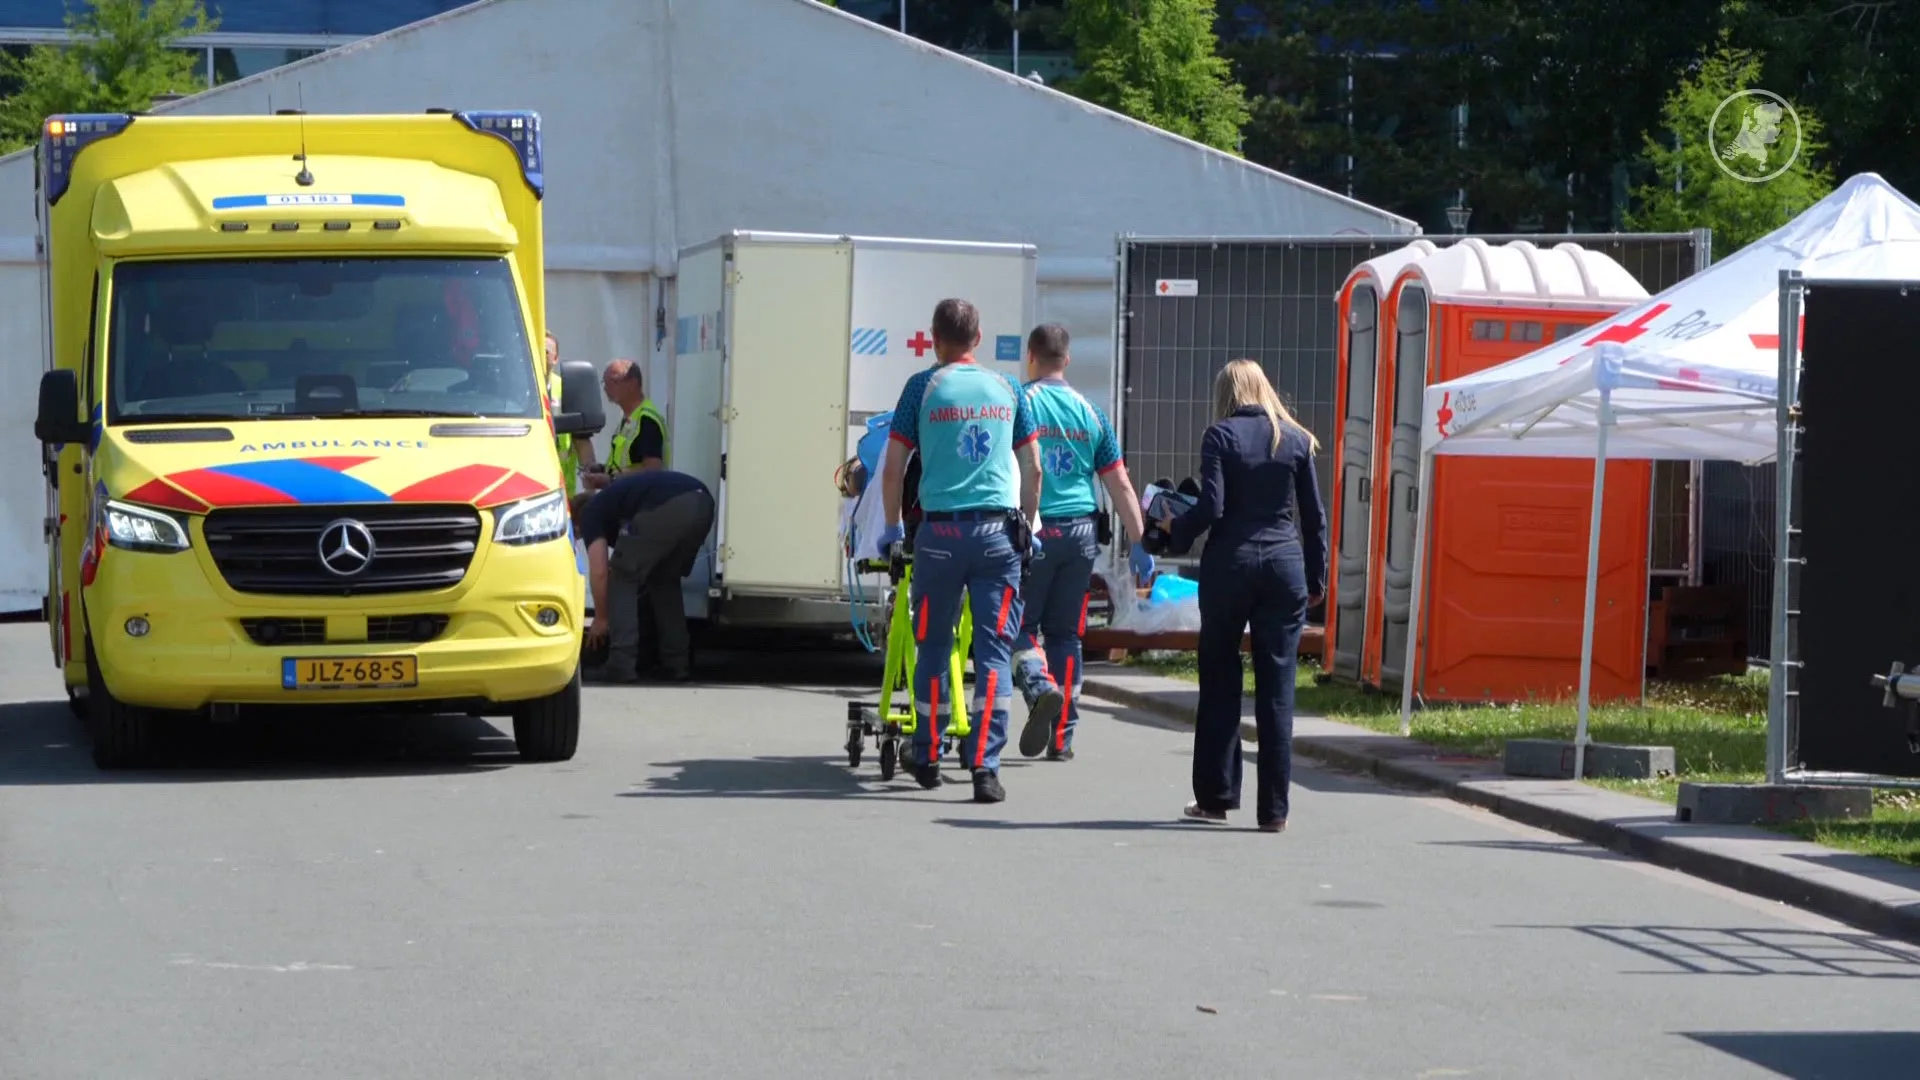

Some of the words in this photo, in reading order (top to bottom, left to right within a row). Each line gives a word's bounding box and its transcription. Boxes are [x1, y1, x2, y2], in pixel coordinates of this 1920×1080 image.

[929, 405, 1012, 422] AMBULANCE
[1037, 424, 1089, 441] BULANC
[240, 439, 428, 453] AMBULANCE
[306, 661, 404, 682] JLZ-68-S
